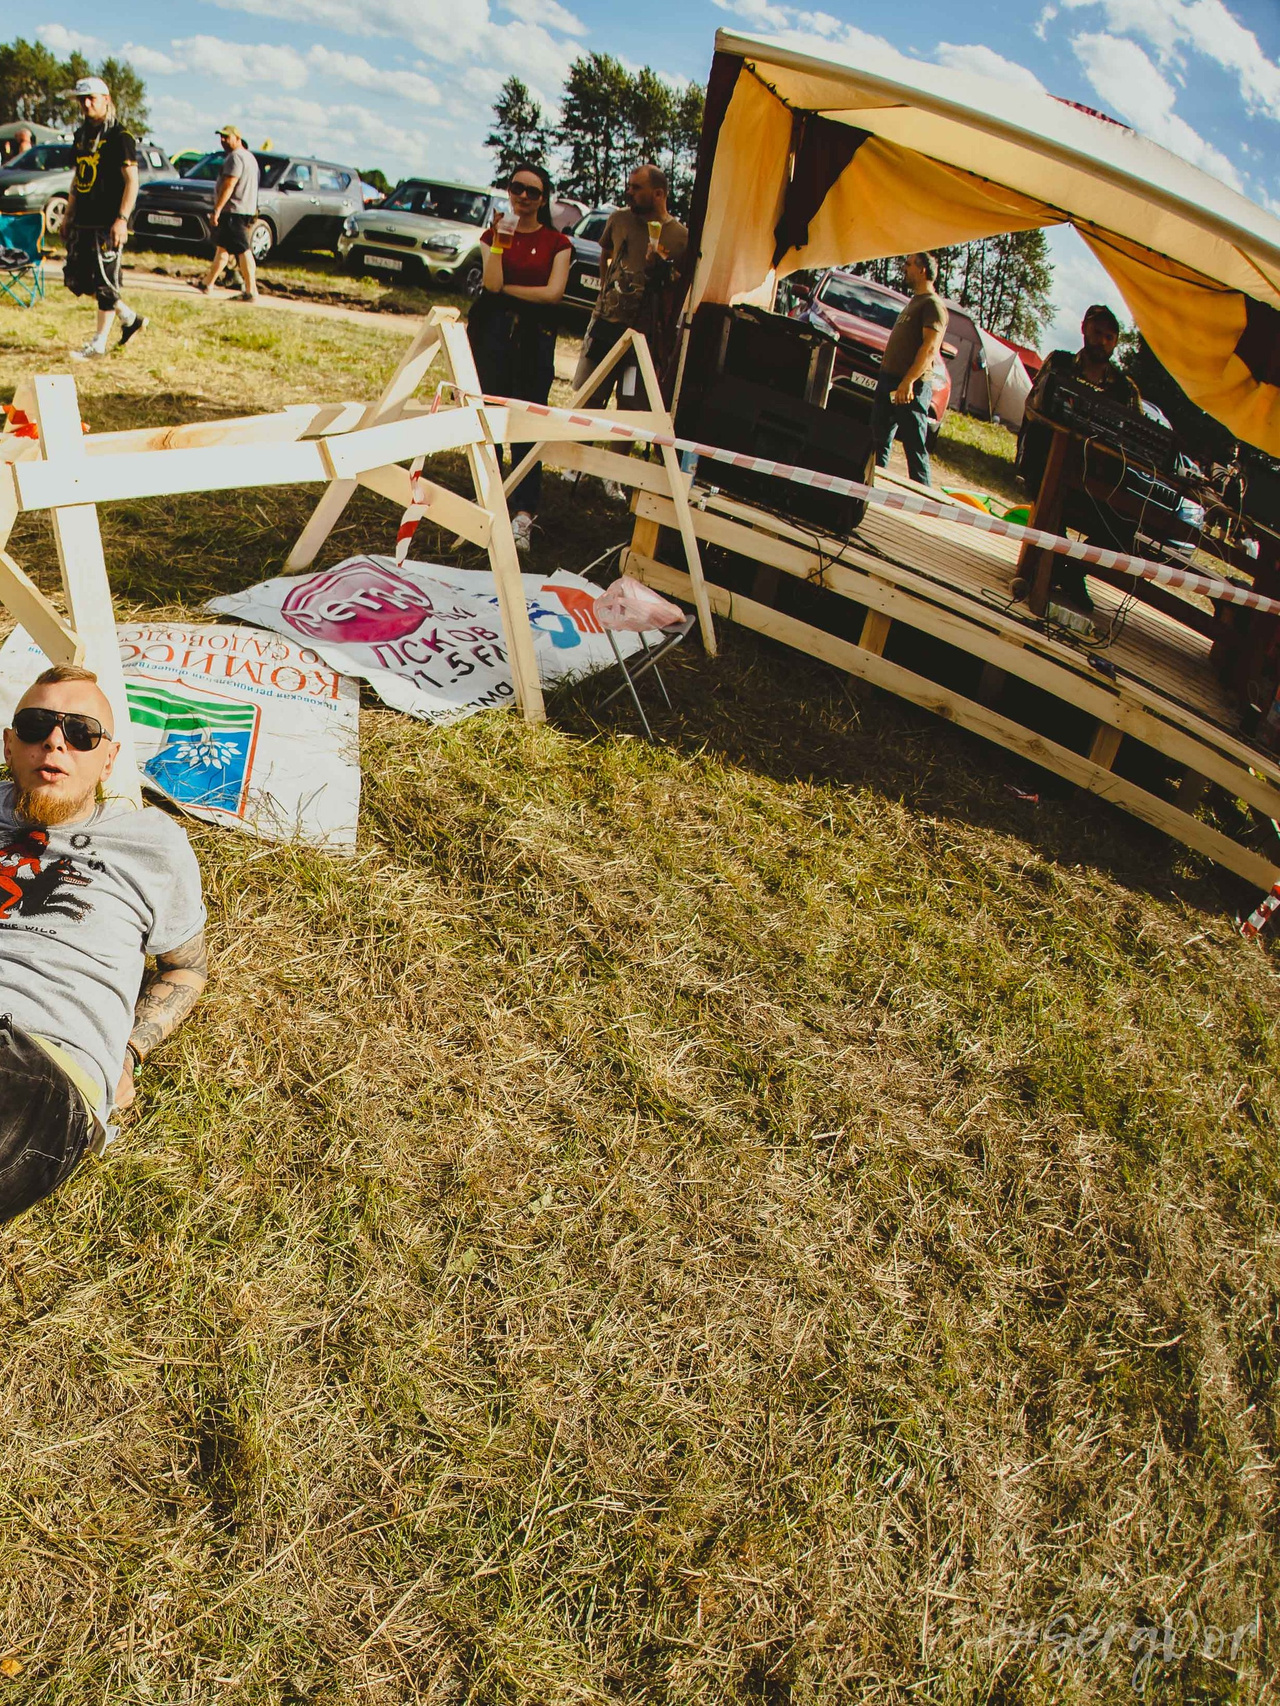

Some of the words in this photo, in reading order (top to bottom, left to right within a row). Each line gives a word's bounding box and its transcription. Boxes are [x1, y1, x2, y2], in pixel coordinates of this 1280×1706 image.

[116, 629, 290, 661] САДОВОДС
[371, 626, 499, 669] ПСКОВ
[25, 925, 57, 935] WILD
